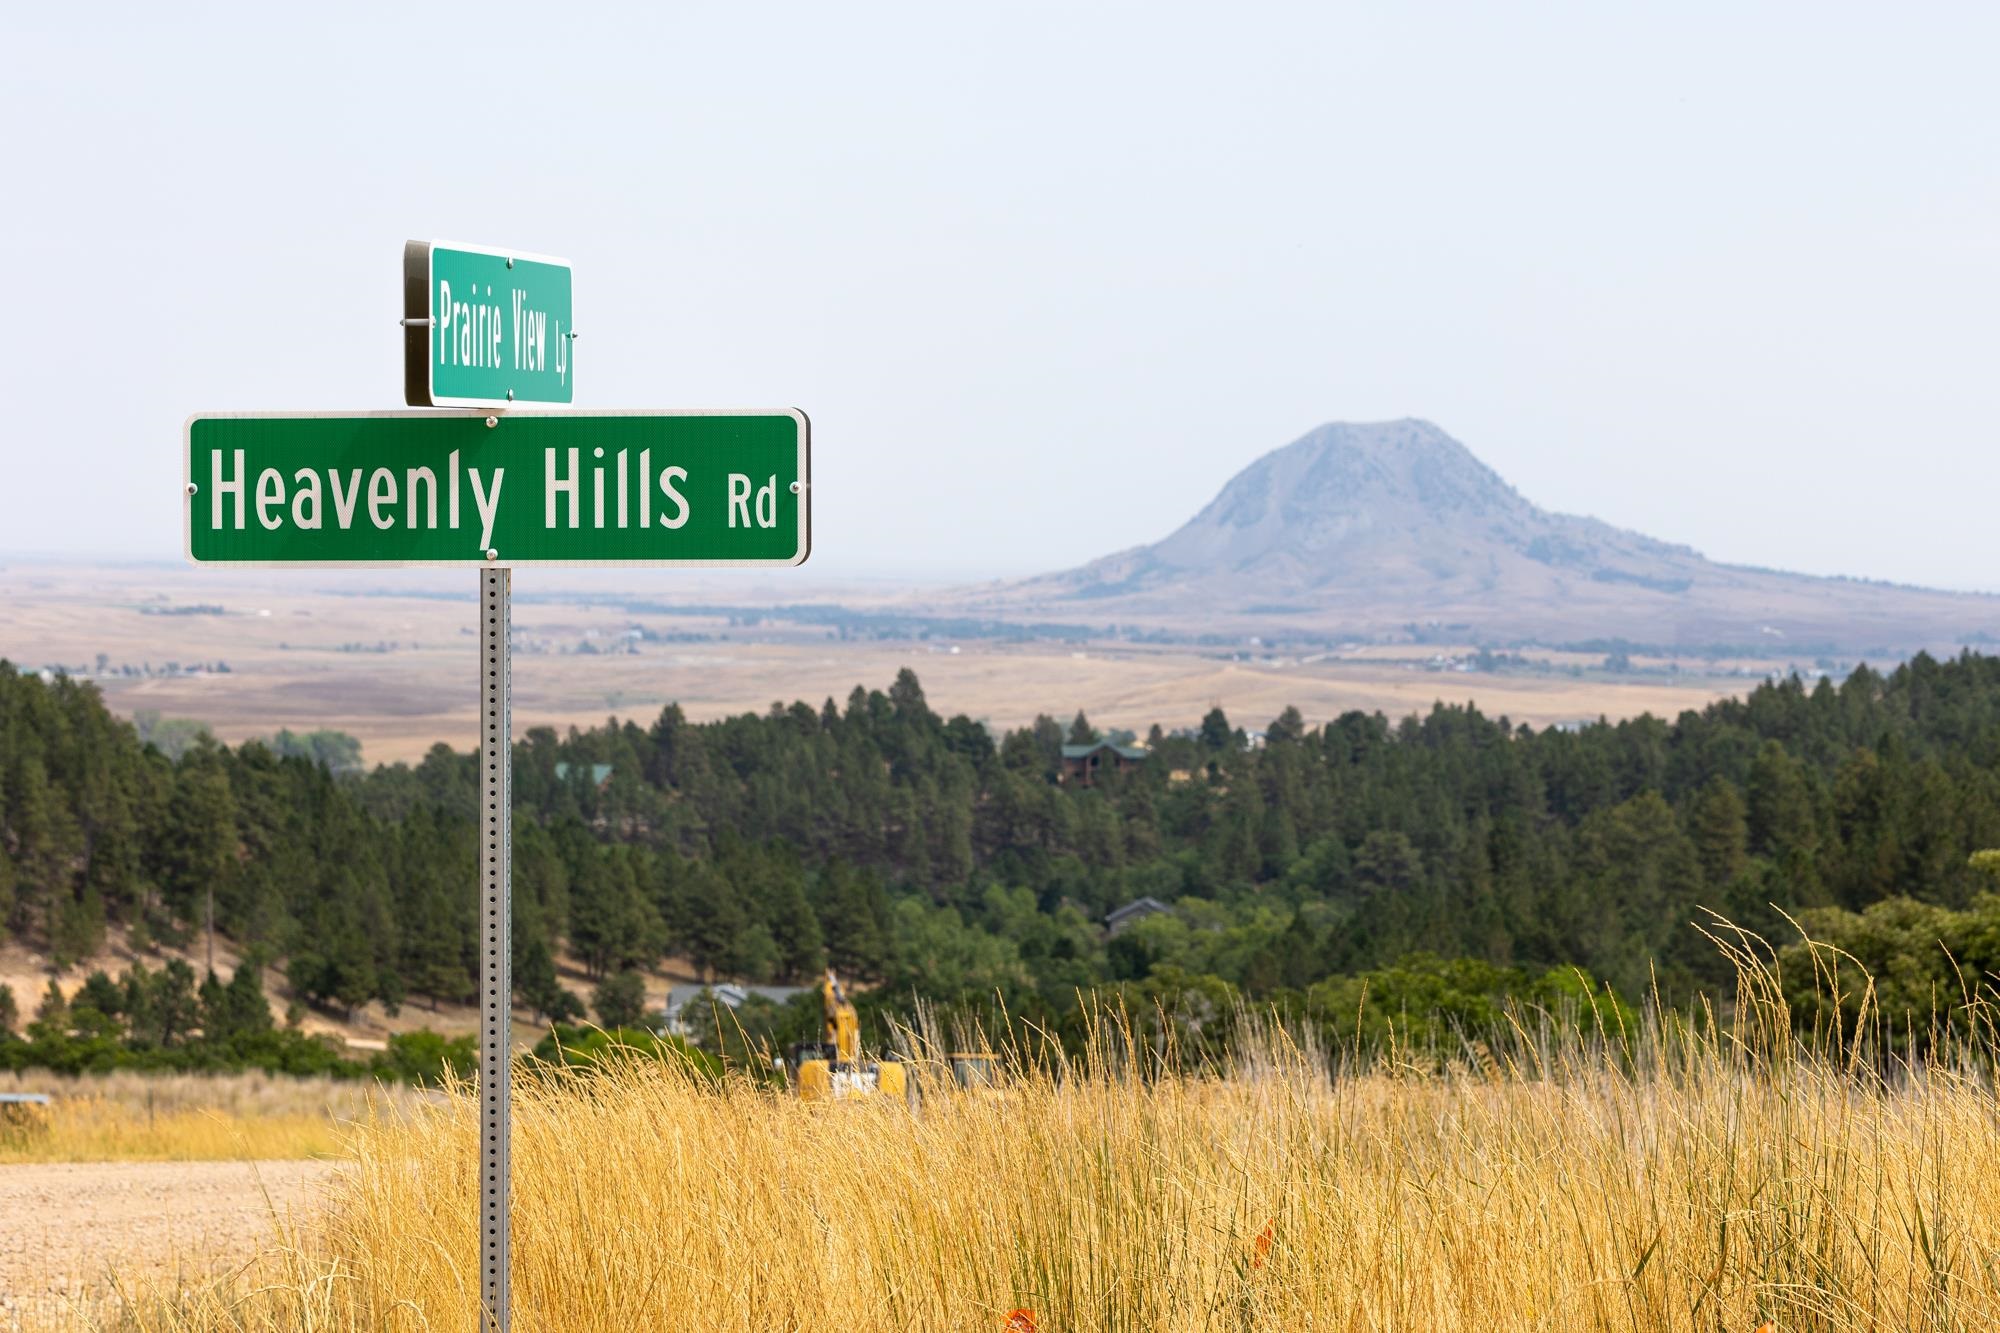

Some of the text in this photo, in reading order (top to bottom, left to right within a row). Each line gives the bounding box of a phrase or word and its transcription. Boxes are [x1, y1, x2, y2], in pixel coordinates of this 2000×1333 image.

[440, 279, 567, 387] Prairie View Lp
[211, 447, 777, 551] Heavenly Hills Rd
